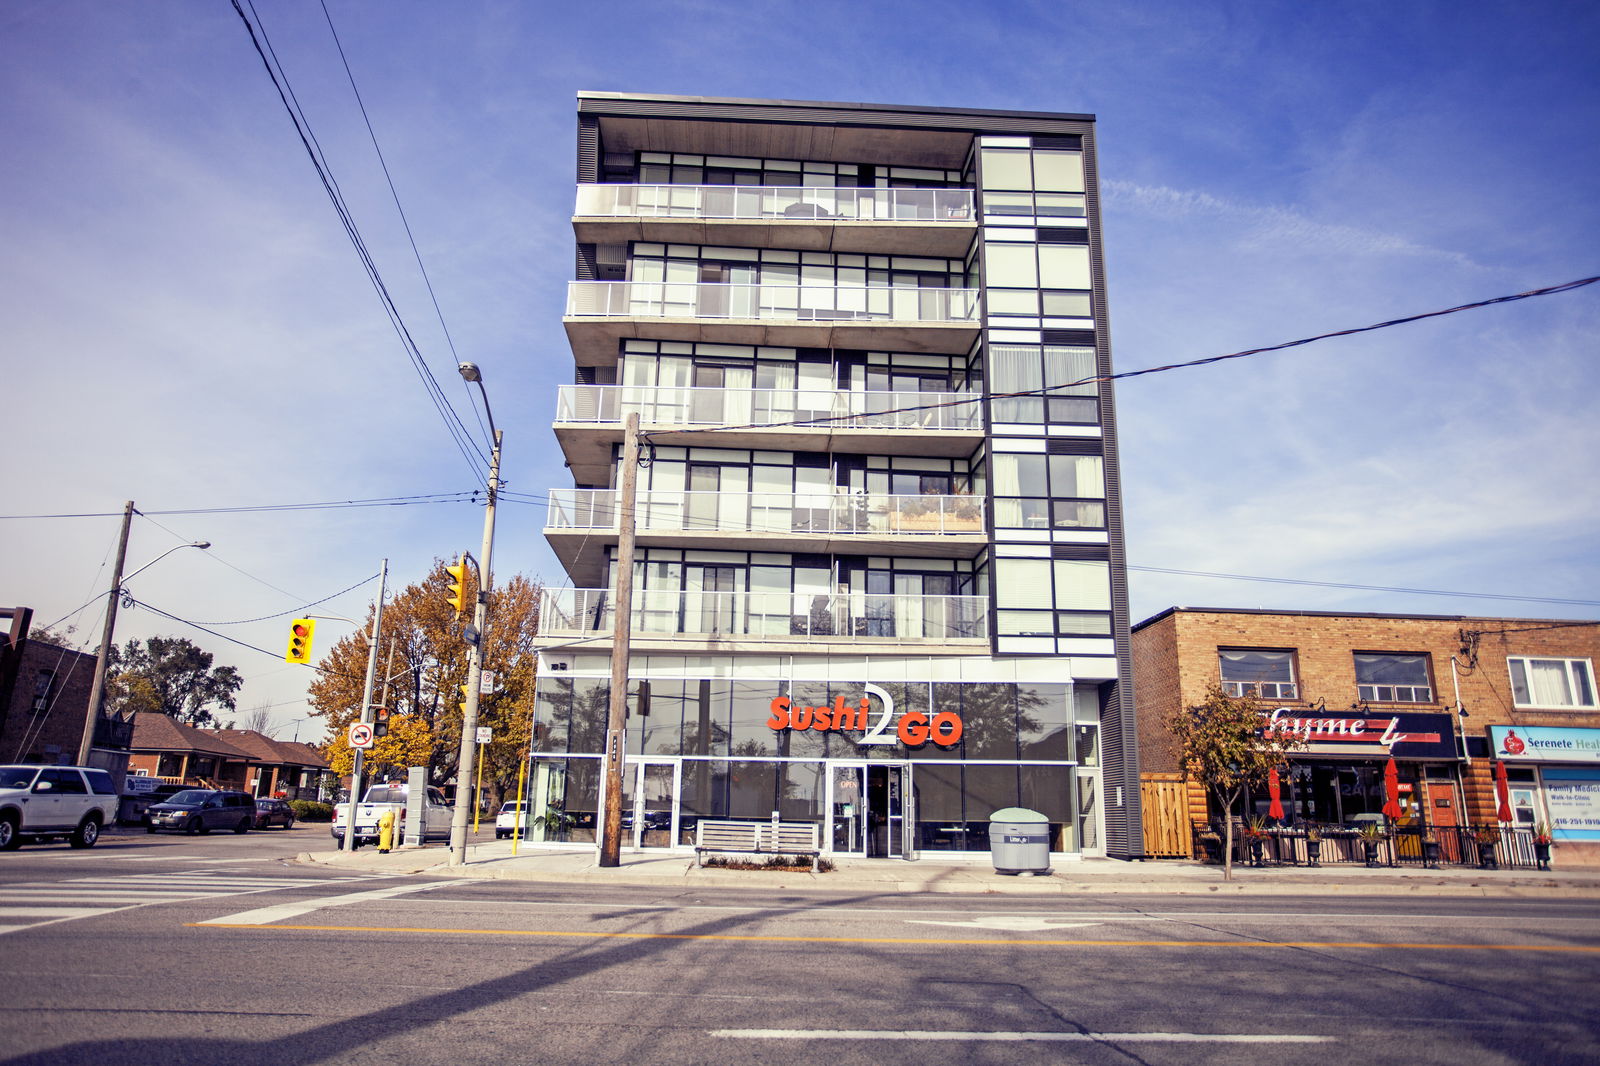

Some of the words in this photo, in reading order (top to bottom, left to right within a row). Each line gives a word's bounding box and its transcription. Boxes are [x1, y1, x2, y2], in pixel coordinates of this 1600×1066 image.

[766, 696, 869, 730] Sushi
[857, 683, 896, 744] 2
[898, 712, 962, 745] GO
[1379, 717, 1407, 750] 4
[1528, 738, 1572, 748] Serenete
[1548, 784, 1573, 793] Family
